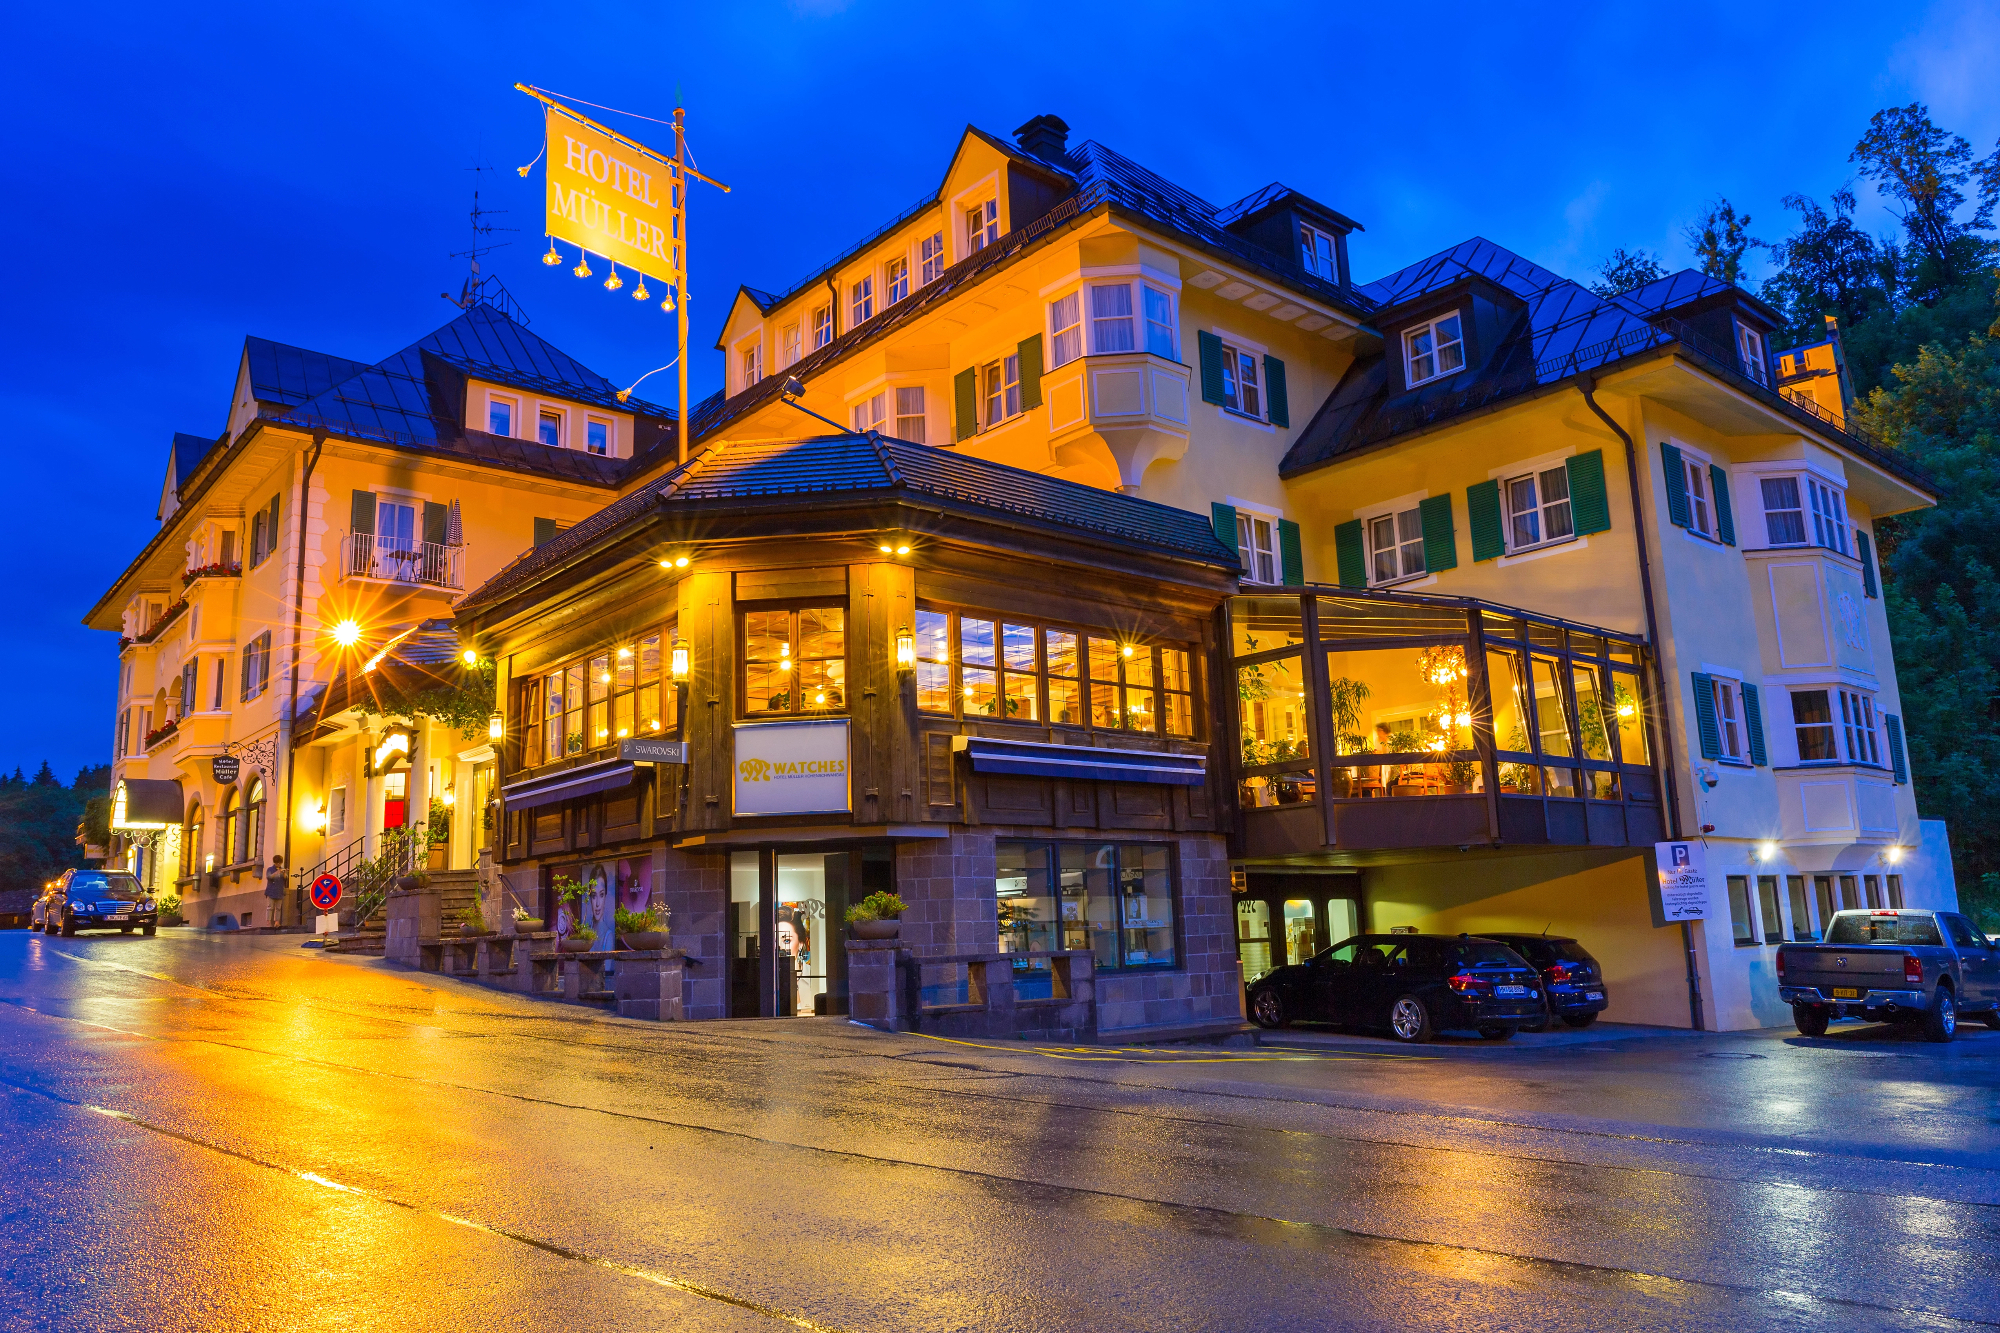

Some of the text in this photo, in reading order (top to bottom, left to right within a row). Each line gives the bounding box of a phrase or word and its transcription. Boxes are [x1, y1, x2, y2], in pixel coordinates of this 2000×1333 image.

[564, 135, 659, 209] HOTEL
[551, 181, 670, 264] MÜLLER
[635, 745, 680, 757] SWAROVSKI
[773, 760, 845, 774] WATCHES
[1675, 848, 1686, 864] P
